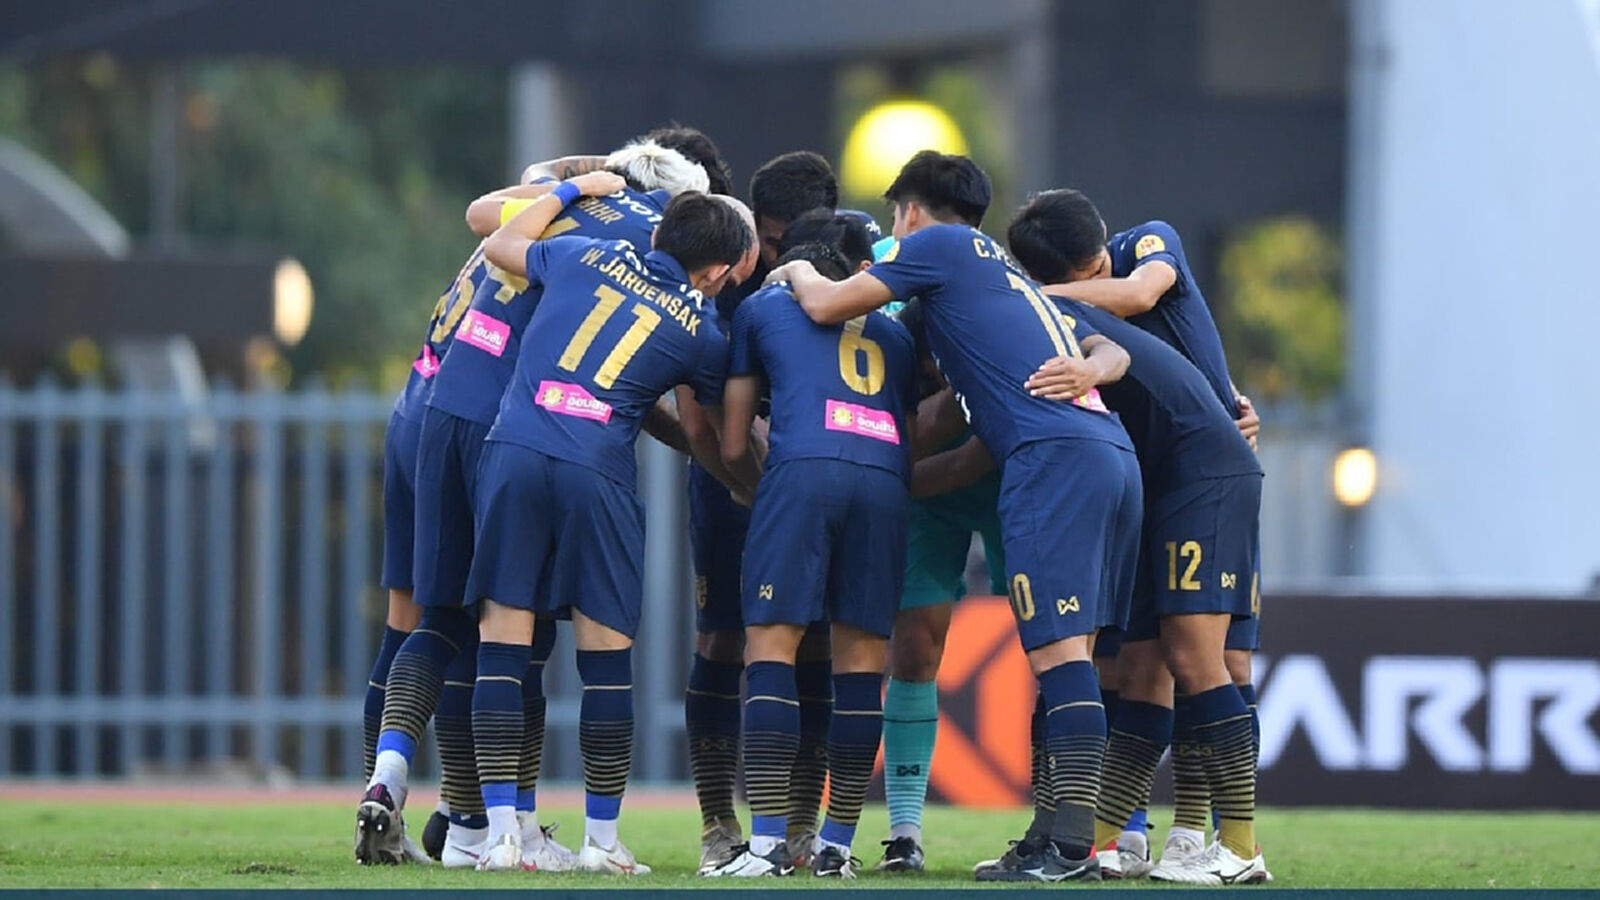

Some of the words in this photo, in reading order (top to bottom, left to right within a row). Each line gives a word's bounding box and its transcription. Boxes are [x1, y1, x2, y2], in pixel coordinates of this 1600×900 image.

[557, 284, 662, 390] 11
[838, 313, 886, 396] 6
[1166, 541, 1202, 591] 12
[1250, 654, 1600, 774] ARR
